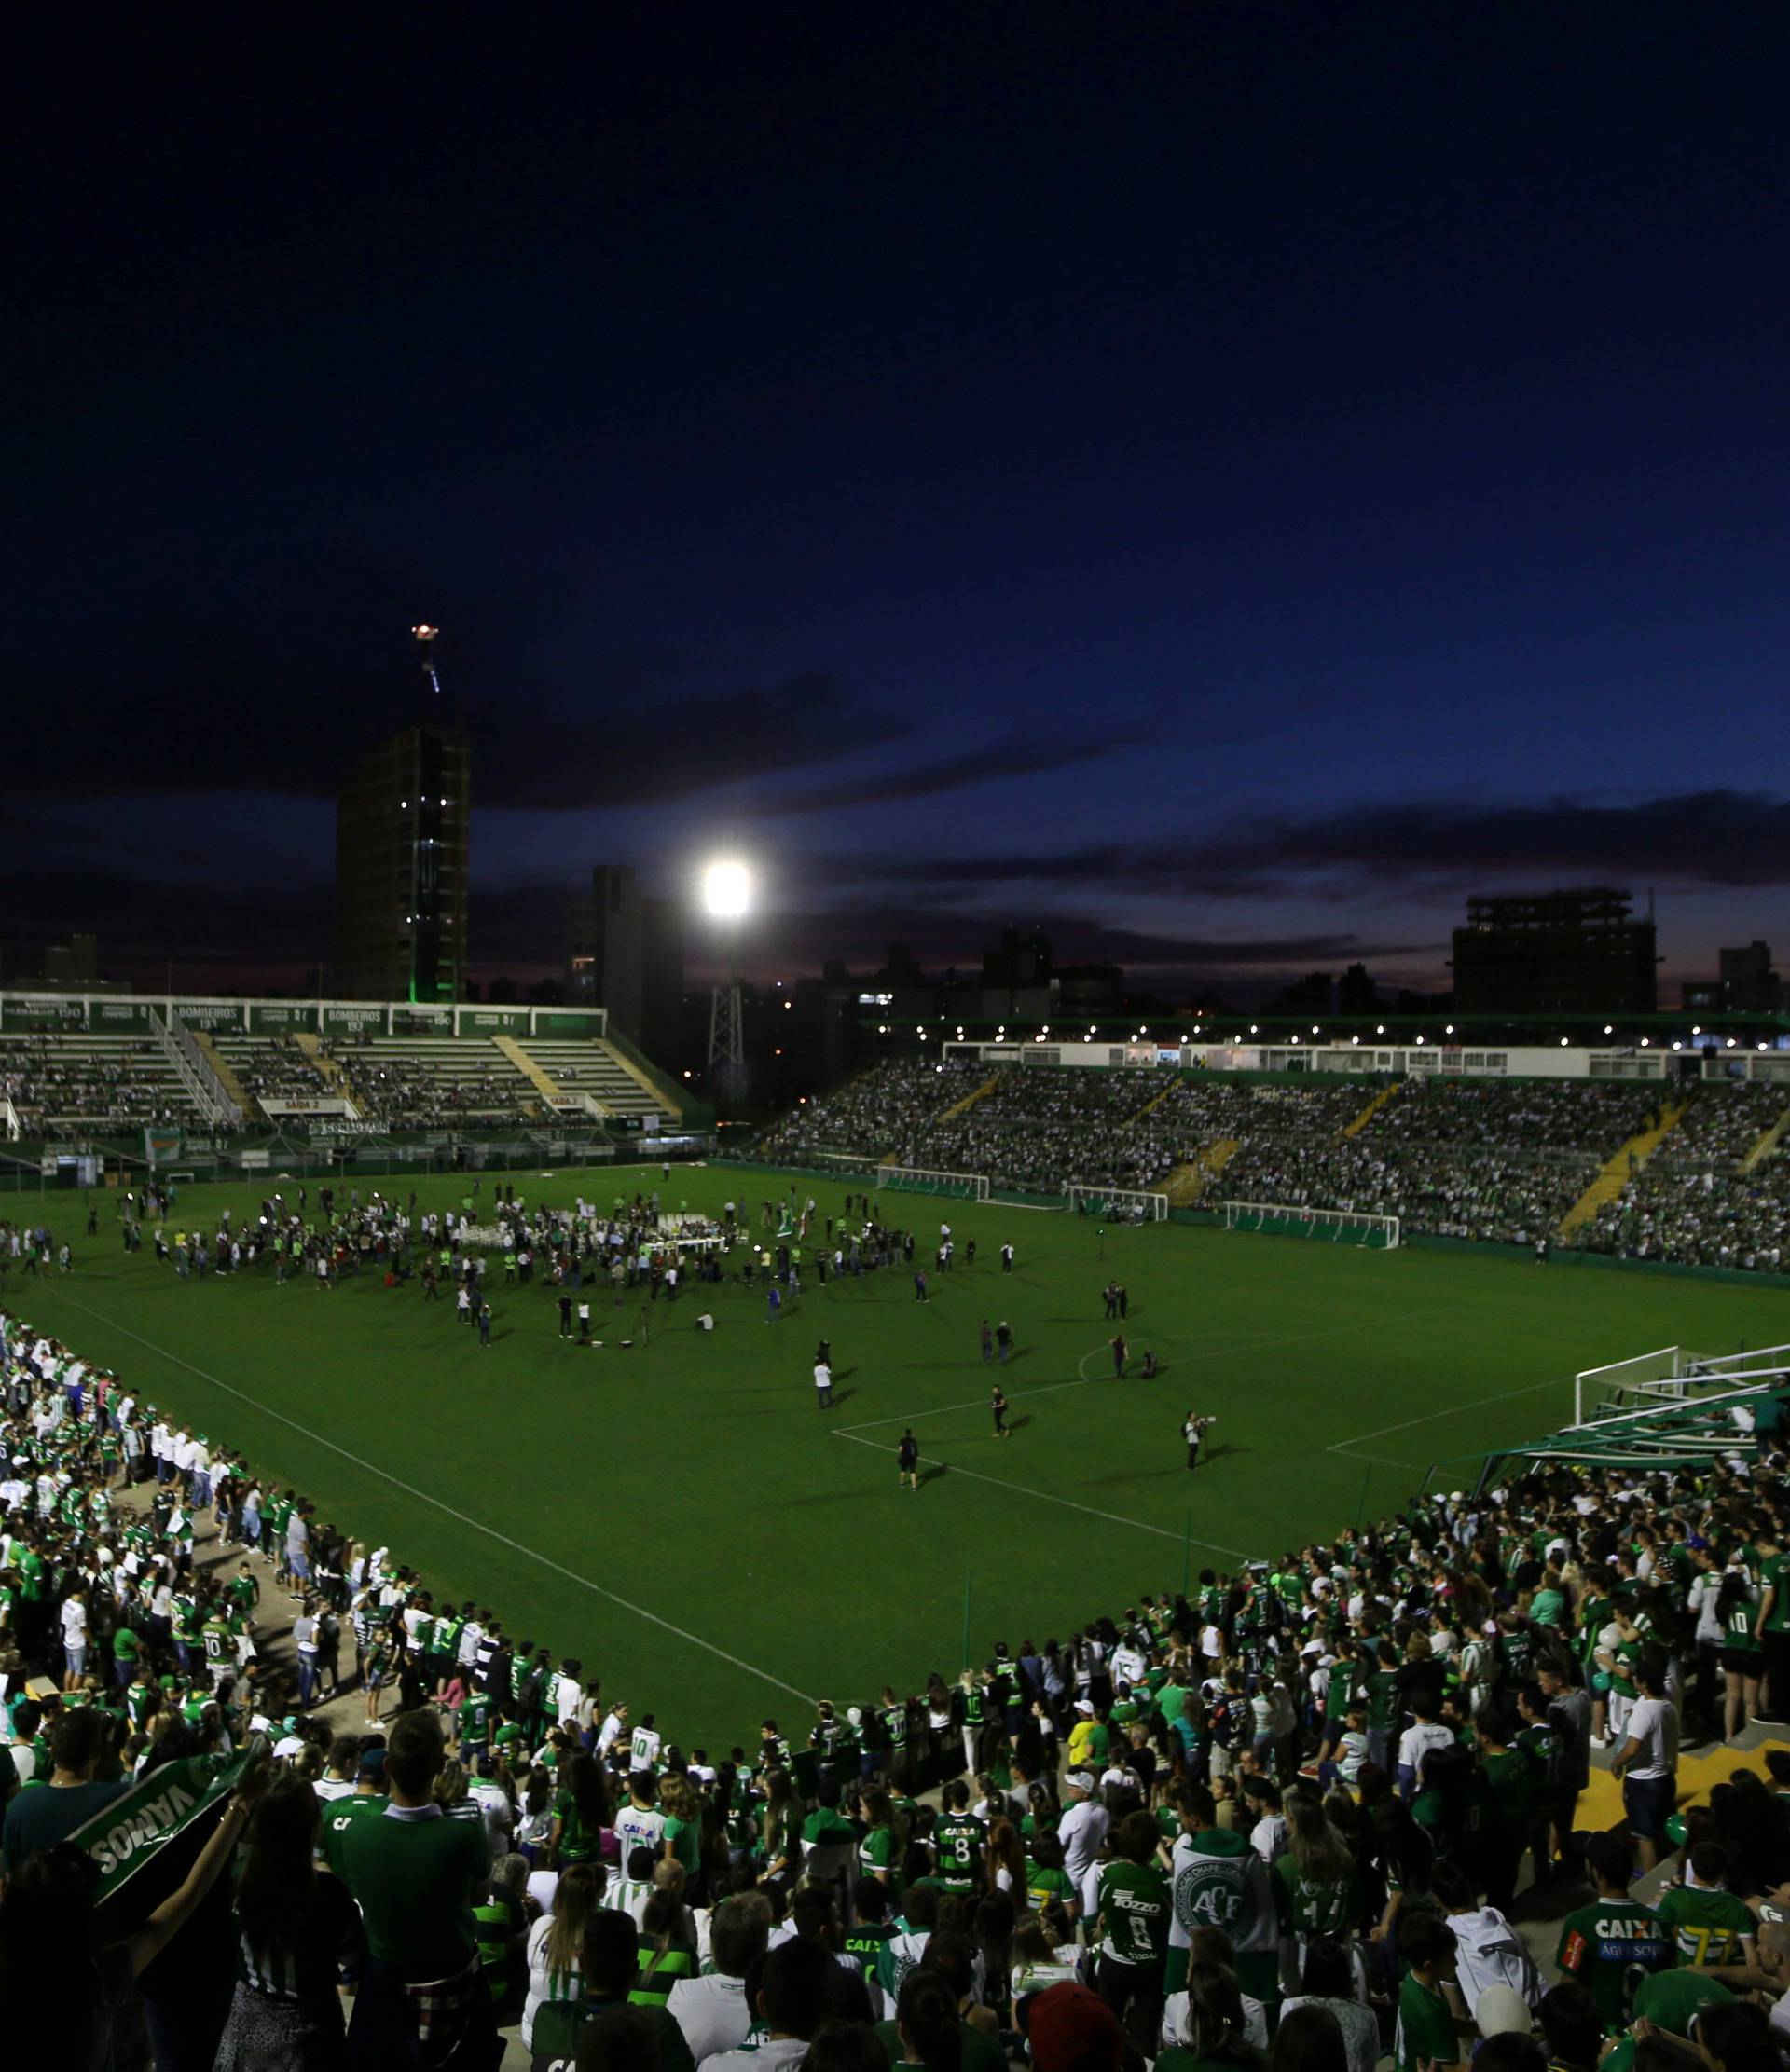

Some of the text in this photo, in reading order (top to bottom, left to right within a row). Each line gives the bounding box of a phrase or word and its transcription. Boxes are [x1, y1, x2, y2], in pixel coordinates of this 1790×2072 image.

[179, 1006, 237, 1019] BOMBEIROS
[328, 1010, 381, 1022] BOMBEIROS
[1728, 1612, 1748, 1634] 10
[206, 1638, 221, 1657] 10
[966, 1696, 981, 1715] 10
[90, 1784, 197, 1875] VAMOS
[624, 1824, 654, 1838] CAIXA
[944, 1827, 975, 1836] CAIXA
[955, 1837, 971, 1863] 8
[1595, 1919, 1663, 1940] CAIXA
